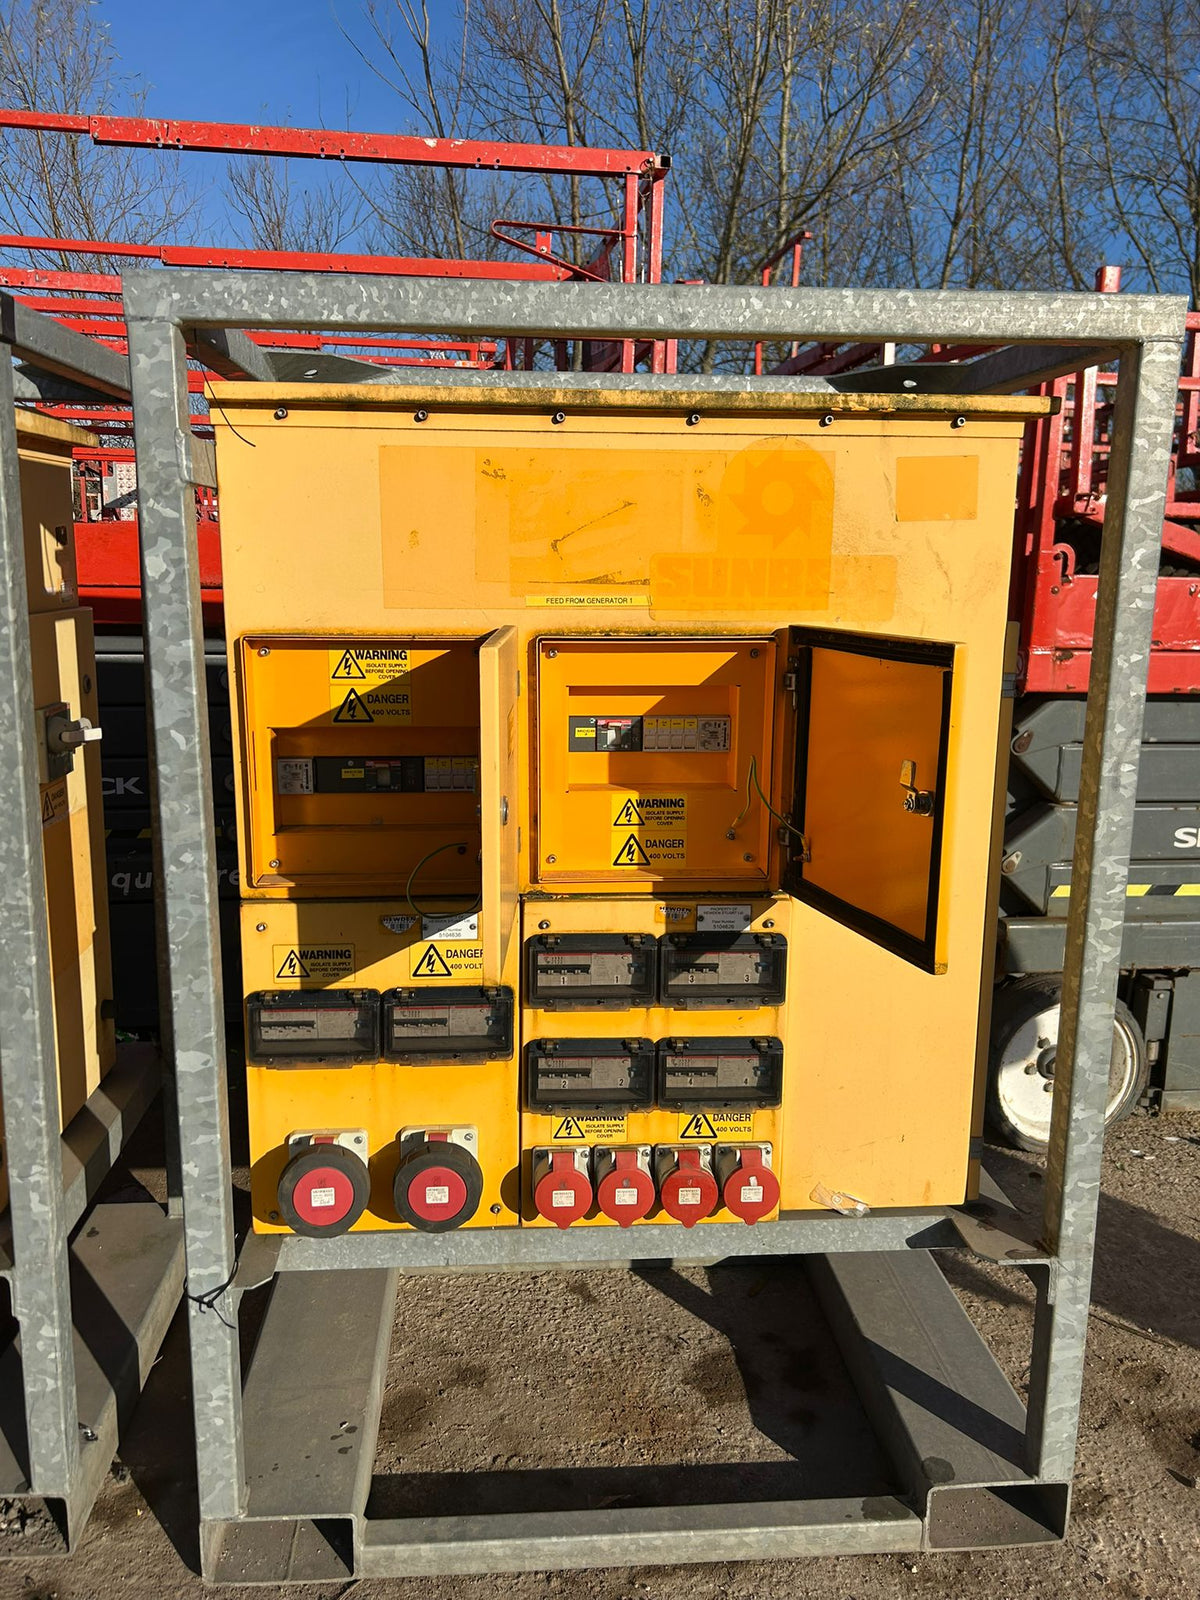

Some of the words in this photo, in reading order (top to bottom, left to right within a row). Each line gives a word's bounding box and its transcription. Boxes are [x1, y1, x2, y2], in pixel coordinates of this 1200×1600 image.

[355, 649, 408, 660] WARNING
[367, 694, 409, 704] DANGER
[102, 777, 144, 795] CK
[635, 798, 685, 809] WARNING
[645, 839, 685, 849] DANGER
[111, 871, 153, 896] qu
[299, 949, 352, 960] WARNING
[560, 977, 566, 985] 1
[614, 975, 620, 983] 1
[689, 975, 695, 983] 3
[744, 975, 750, 983] 3
[562, 1080, 568, 1089] 2
[619, 1079, 624, 1087] 2
[688, 1077, 694, 1086] 4
[743, 1078, 749, 1086] 4
[712, 1113, 752, 1122] DANGER
